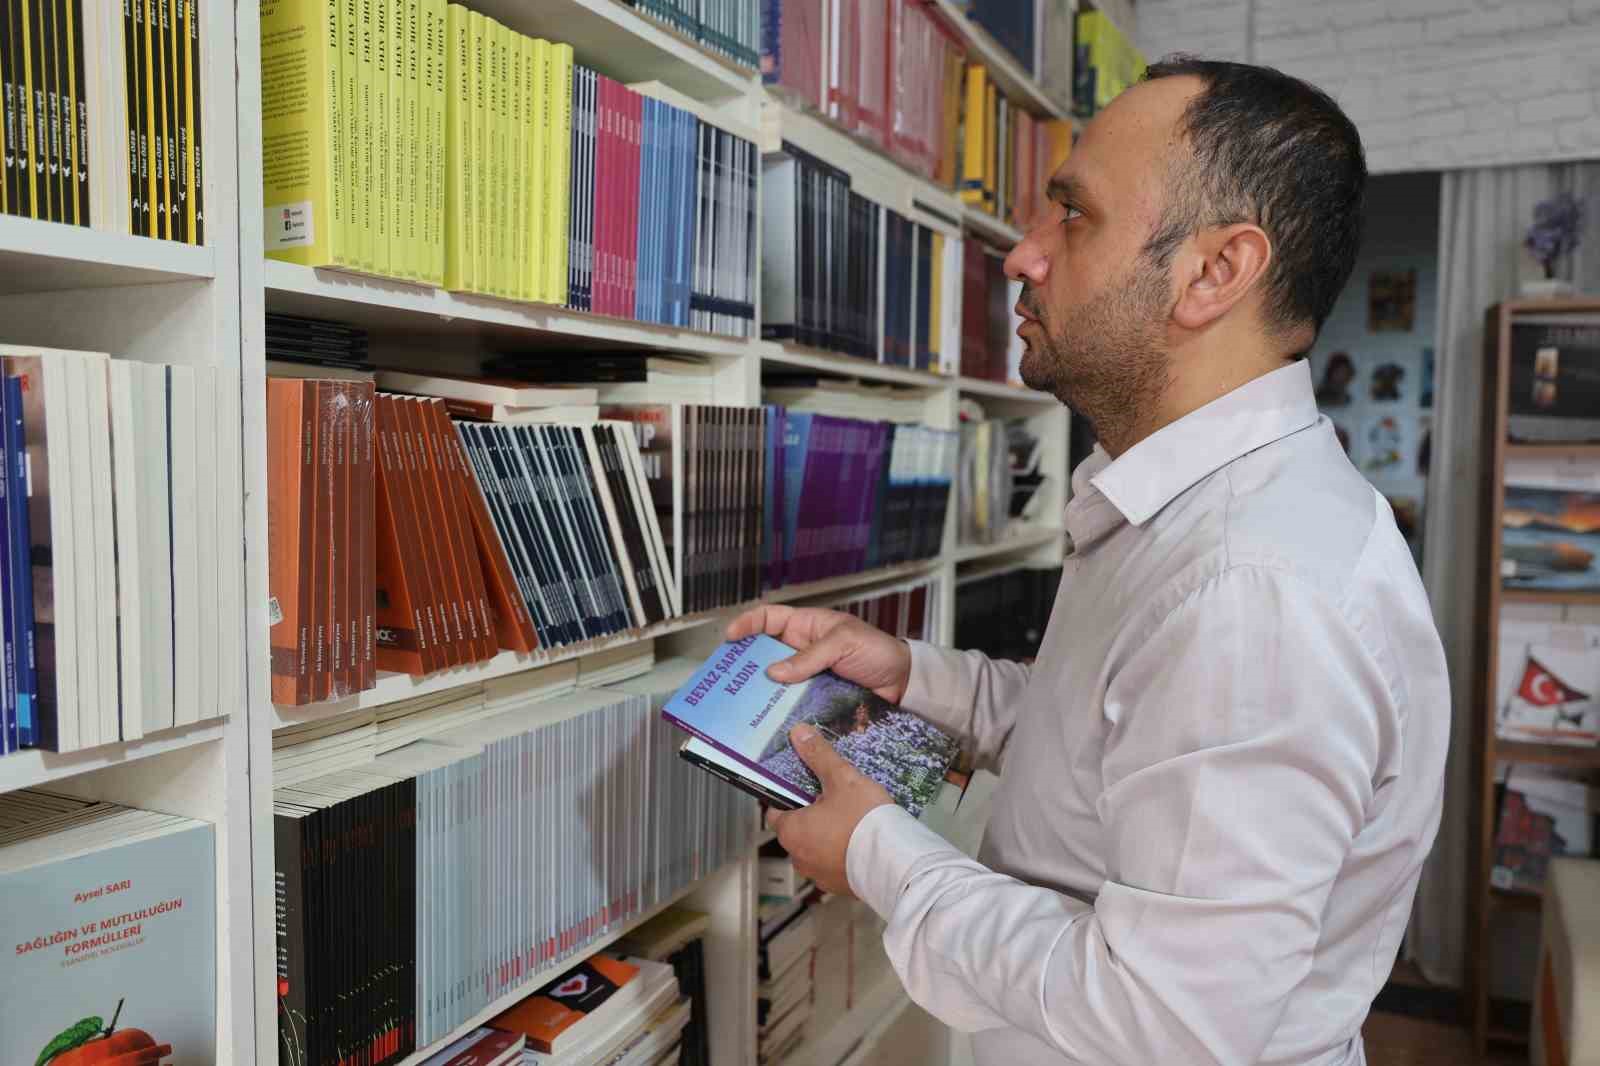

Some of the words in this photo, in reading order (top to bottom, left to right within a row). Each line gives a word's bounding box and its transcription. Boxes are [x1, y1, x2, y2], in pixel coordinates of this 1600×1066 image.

[684, 670, 721, 707] BEYAZ
[723, 660, 760, 696] KADIN
[74, 888, 103, 904] Aysel
[106, 879, 131, 894] SARI
[15, 928, 78, 956] SAĞLIĞIN
[81, 922, 97, 936] VE
[100, 897, 183, 931] MUTLULUĞUN
[64, 923, 142, 957] FORMÜLLERİ
